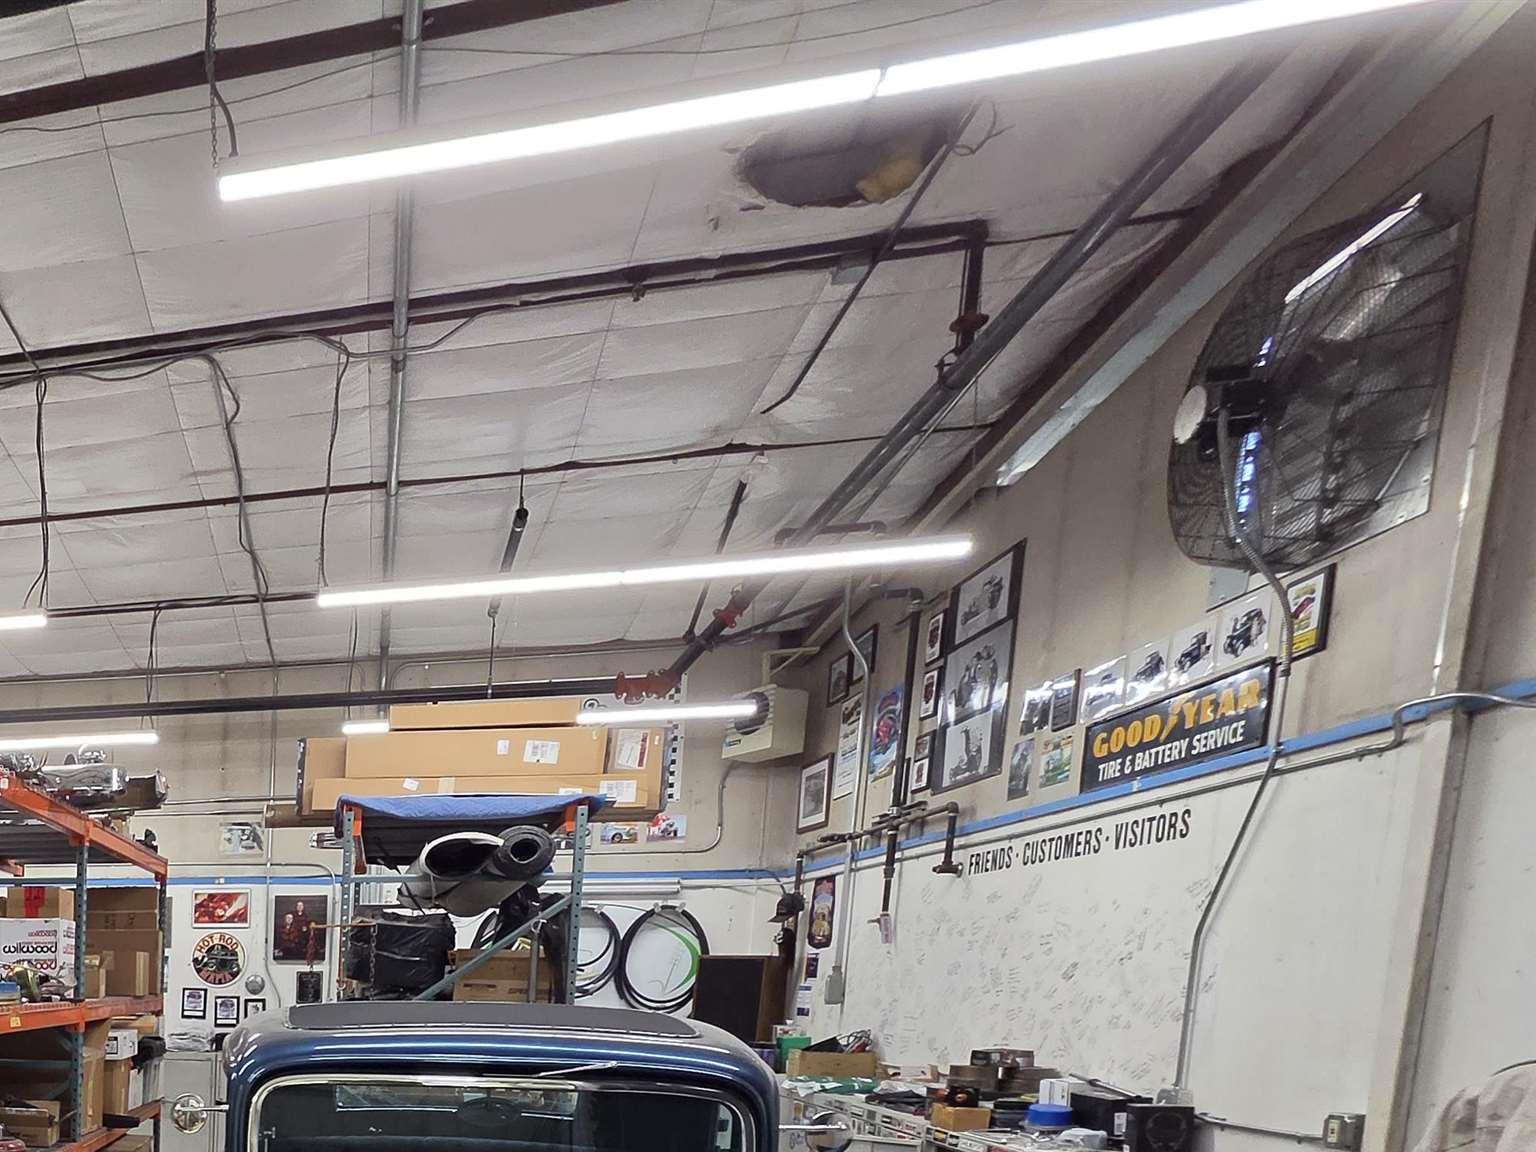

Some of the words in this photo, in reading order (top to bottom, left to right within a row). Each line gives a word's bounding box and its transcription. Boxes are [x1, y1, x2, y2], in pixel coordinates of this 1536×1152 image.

[1097, 763, 1121, 782] TIRE
[1134, 739, 1189, 772] BATTERY
[1191, 720, 1246, 755] SERVICE
[968, 846, 1014, 876] FRIENDS
[1022, 827, 1104, 866] CUSTOMERS
[1113, 808, 1192, 850] VISITORS
